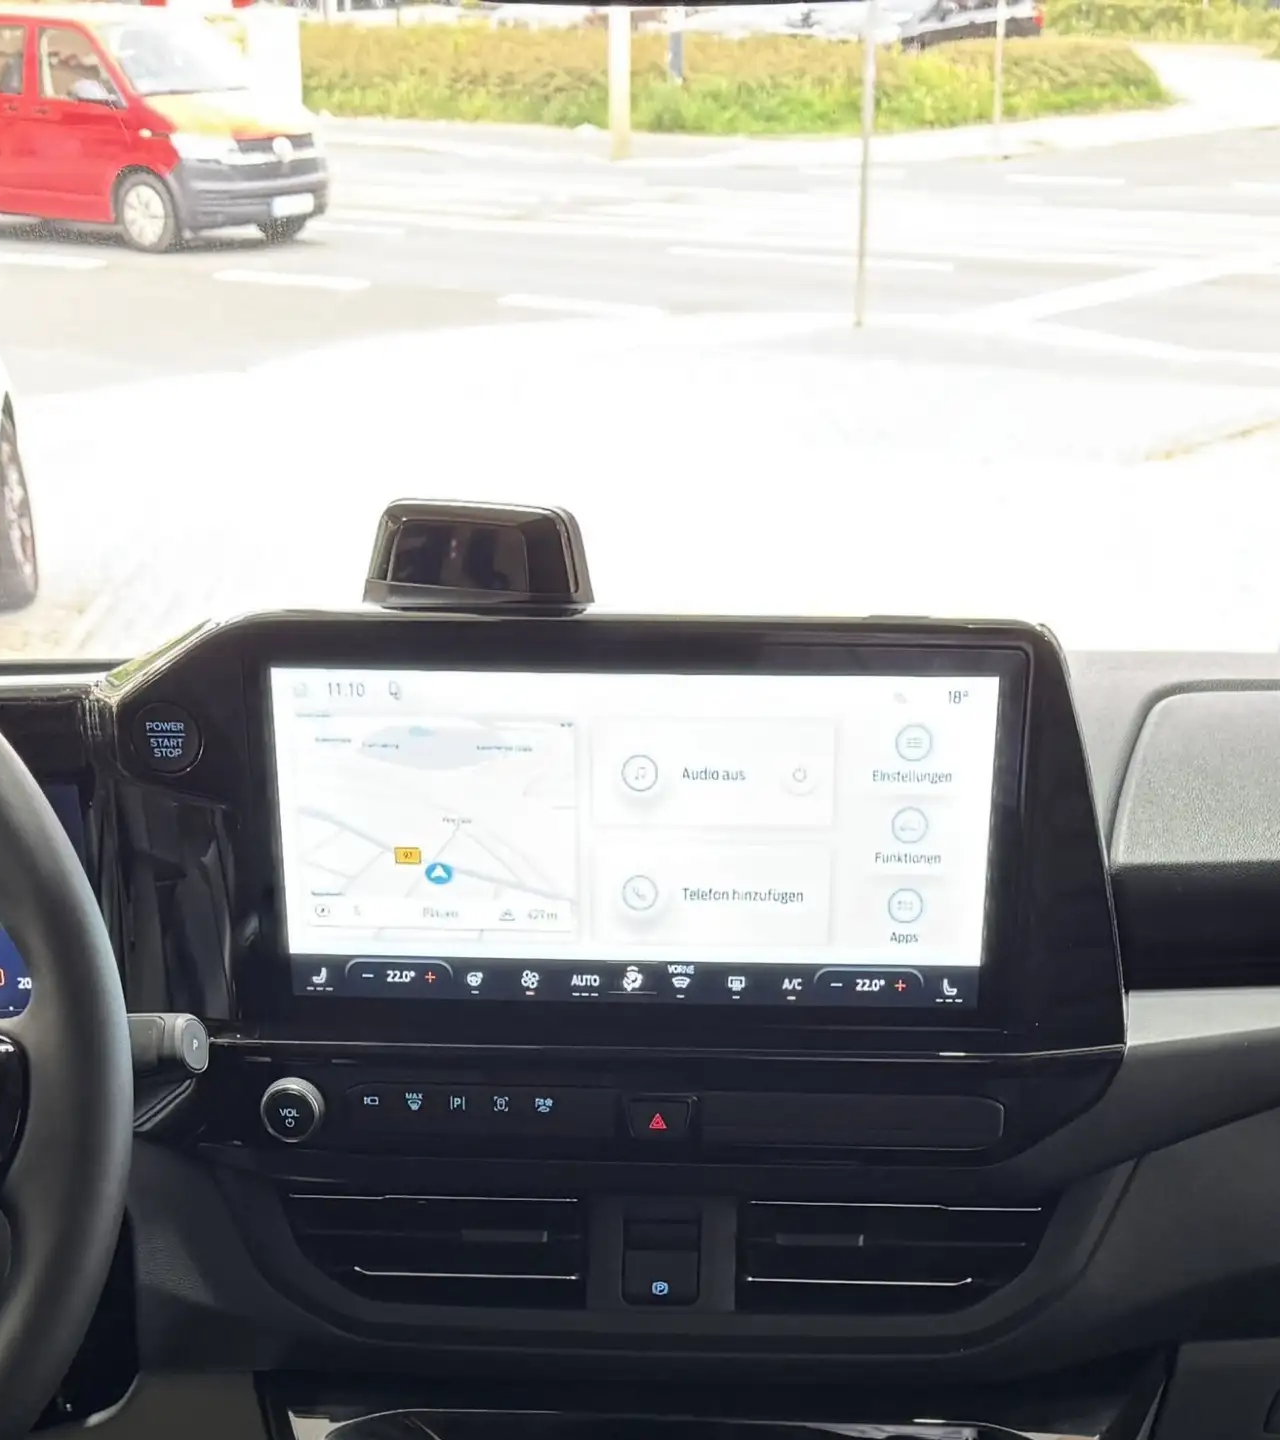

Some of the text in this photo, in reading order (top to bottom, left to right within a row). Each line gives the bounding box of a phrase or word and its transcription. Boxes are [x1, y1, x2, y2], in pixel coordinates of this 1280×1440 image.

[145, 721, 185, 732] POWER
[149, 737, 184, 748] START
[153, 748, 183, 758] STOP
[681, 767, 747, 782] Audio aus
[872, 769, 953, 785] Einstellungen
[874, 851, 942, 866] Funktionen
[681, 887, 730, 902] Telefon
[889, 930, 920, 945] Apps
[667, 964, 696, 976] VORNE
[570, 973, 600, 987] AUTO
[782, 978, 803, 991] A/C
[405, 1092, 424, 1100] MAX
[279, 1108, 300, 1118] VOL
